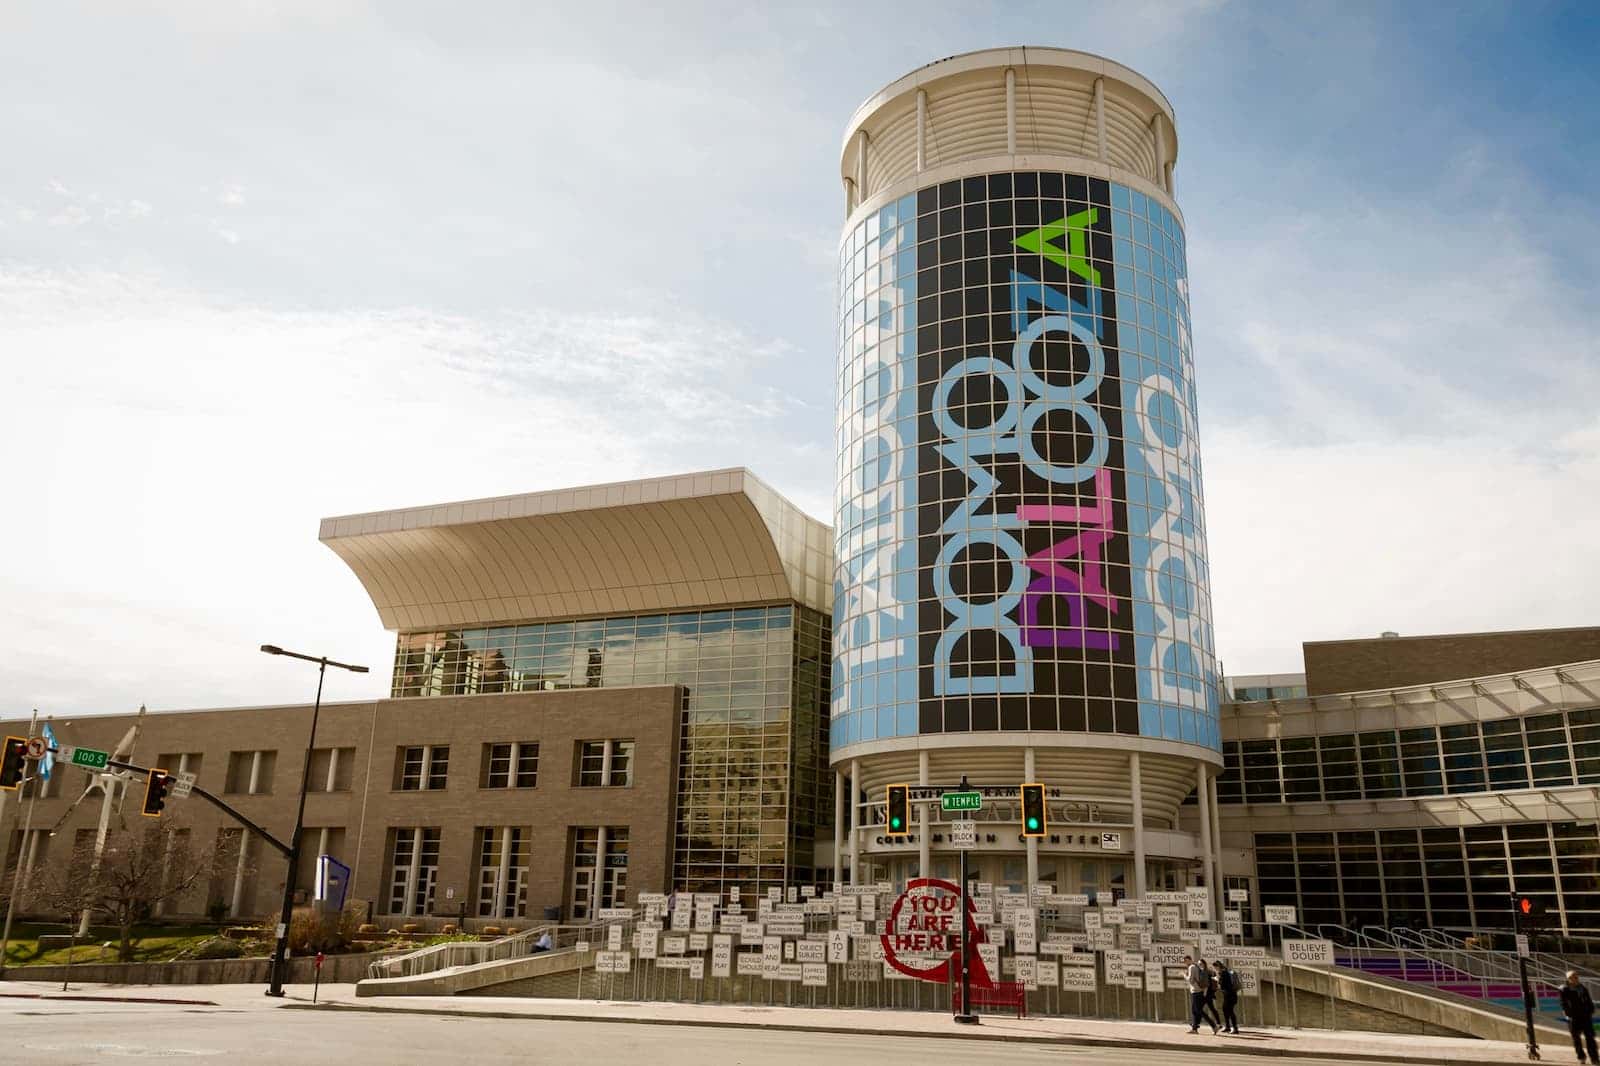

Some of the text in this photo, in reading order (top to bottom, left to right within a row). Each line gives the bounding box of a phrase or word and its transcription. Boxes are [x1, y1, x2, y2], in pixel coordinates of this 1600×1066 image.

[1009, 207, 1120, 651] PALOOZA
[932, 357, 1034, 696] DOMO
[79, 751, 95, 762] 100
[97, 754, 104, 764] S
[944, 796, 980, 807] W TEMPLE
[911, 896, 957, 912] YOU
[907, 915, 954, 932] ARE
[835, 934, 842, 942] A
[896, 935, 962, 950] HERE
[832, 943, 844, 951] TO
[1157, 946, 1185, 955] INSIDE
[1290, 943, 1326, 953] BELIEVE
[834, 952, 841, 960] Z
[1219, 948, 1236, 956] LOST
[1292, 952, 1326, 961] DOUBT
[1105, 953, 1123, 961] NEA
[1153, 955, 1185, 964] OUTSID
[1018, 959, 1034, 967] GIVE
[1110, 963, 1122, 971] OR
